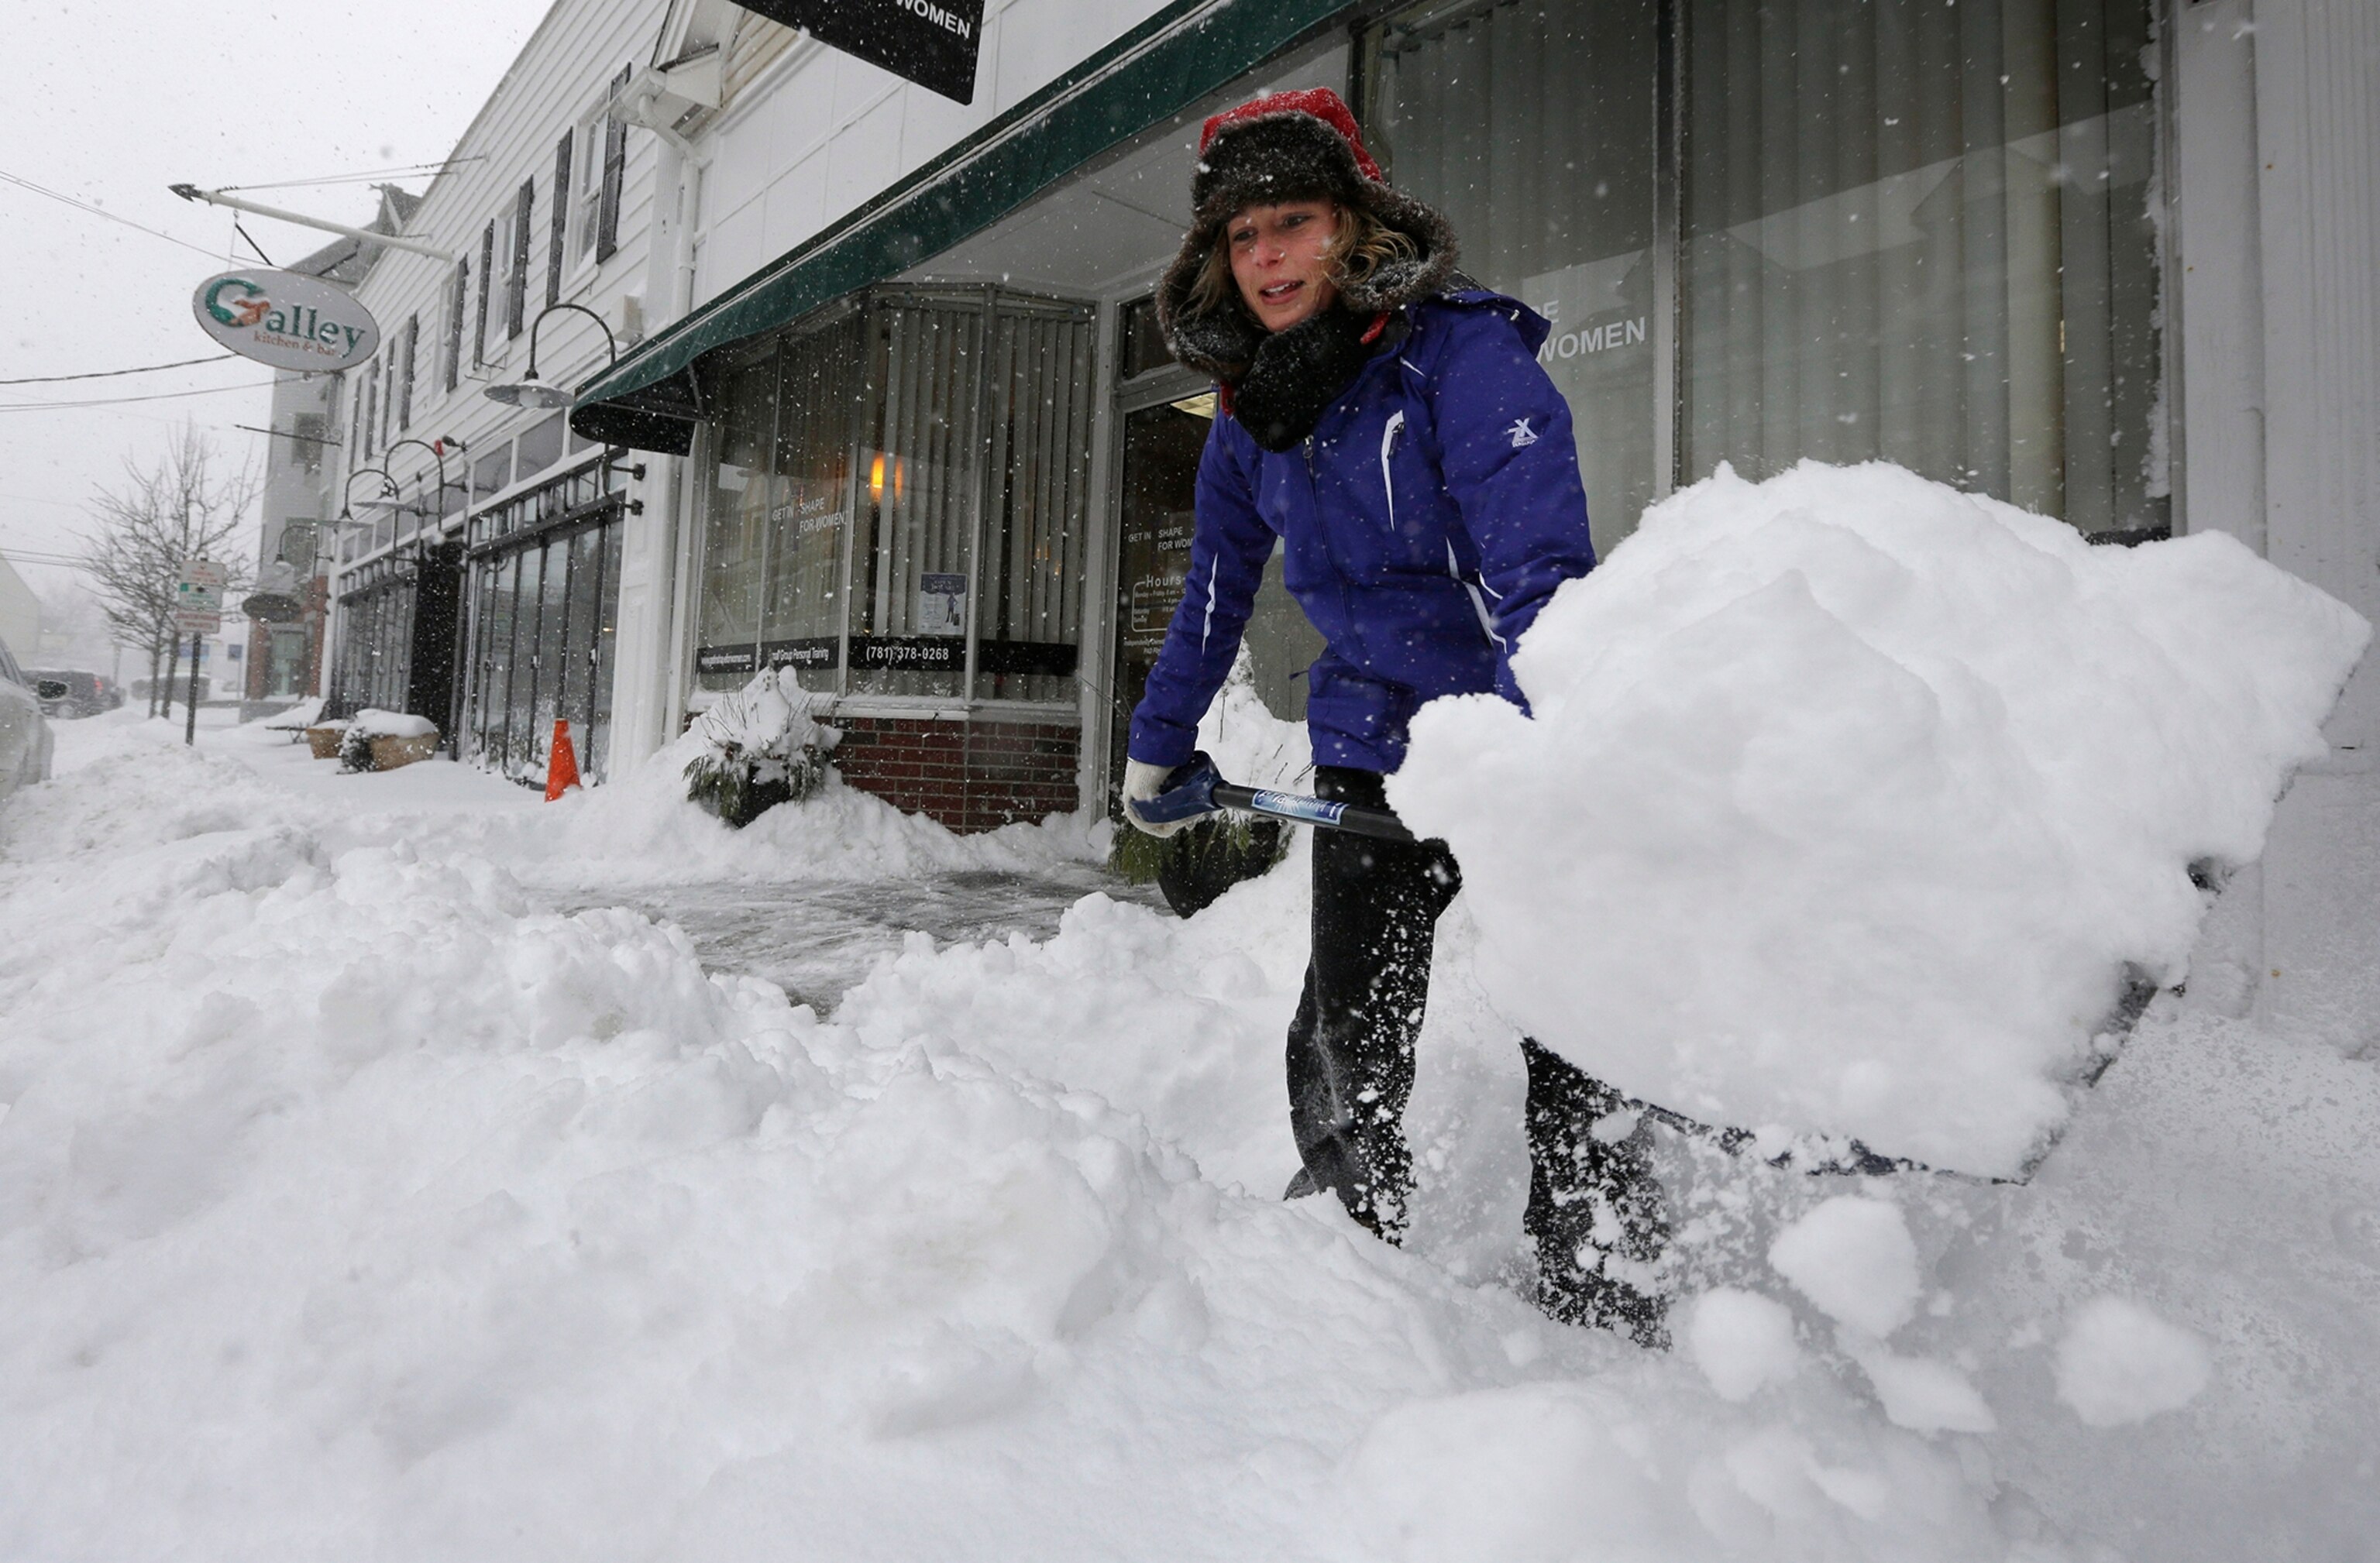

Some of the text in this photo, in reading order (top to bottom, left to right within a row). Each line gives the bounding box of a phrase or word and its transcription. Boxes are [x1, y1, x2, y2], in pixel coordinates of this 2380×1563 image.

[205, 278, 366, 359] Galley
[253, 330, 300, 349] kitchen
[801, 497, 825, 514] SHAPE
[800, 518, 814, 533] FOR
[1128, 527, 1183, 543] GET IN SHAPE
[1157, 541, 1173, 551] FOR
[866, 646, 949, 665] (781) 378-0268
